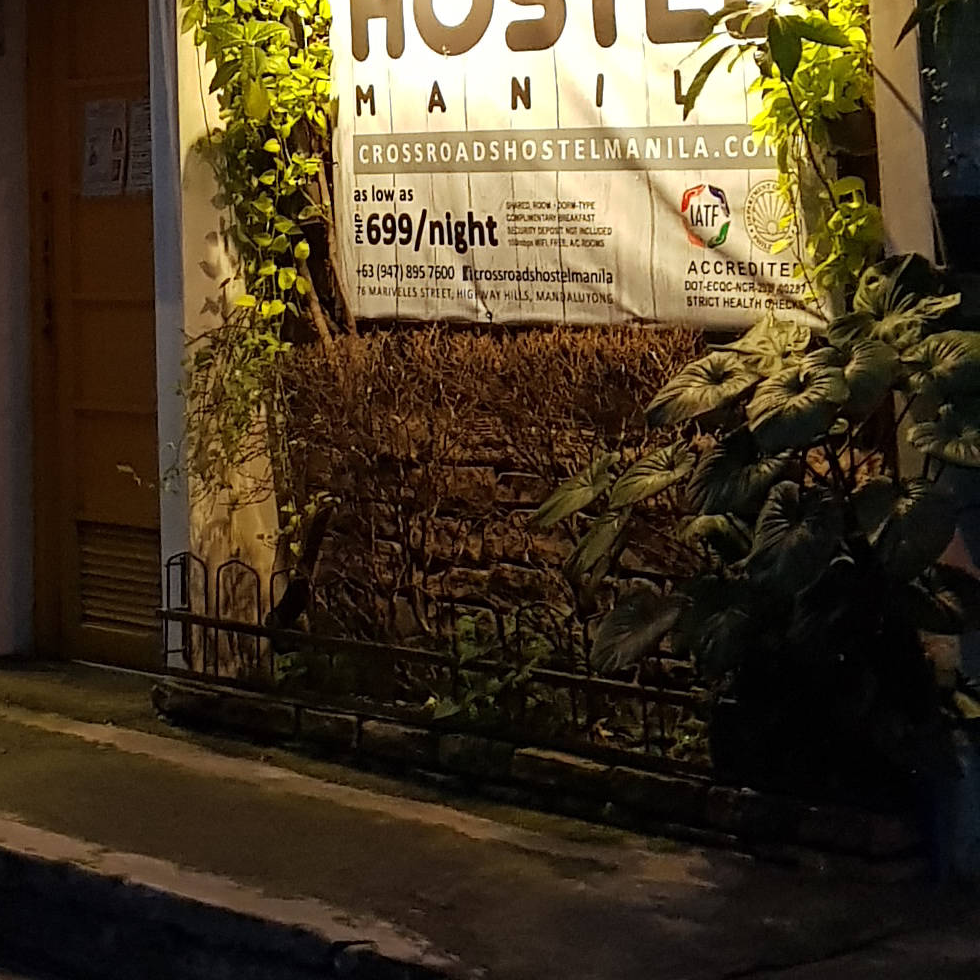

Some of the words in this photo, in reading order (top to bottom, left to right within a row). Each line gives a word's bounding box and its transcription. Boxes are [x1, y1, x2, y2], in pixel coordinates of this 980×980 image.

[356, 69, 690, 117] MANIL
[354, 189, 367, 202] as
[372, 184, 395, 202] low
[399, 189, 414, 201] as
[689, 204, 719, 227] IATF
[355, 213, 363, 244] PHP
[366, 209, 499, 254] 699/night
[356, 264, 374, 278] +63
[376, 263, 403, 282] (947)
[405, 265, 426, 279] 895
[427, 265, 455, 279] 7600
[368, 286, 418, 298] MARIVELES
[420, 287, 455, 300] STREET,
[536, 291, 614, 305] MANDALUYONG
[686, 296, 720, 308] STRICT
[723, 297, 762, 309] HEALTH
